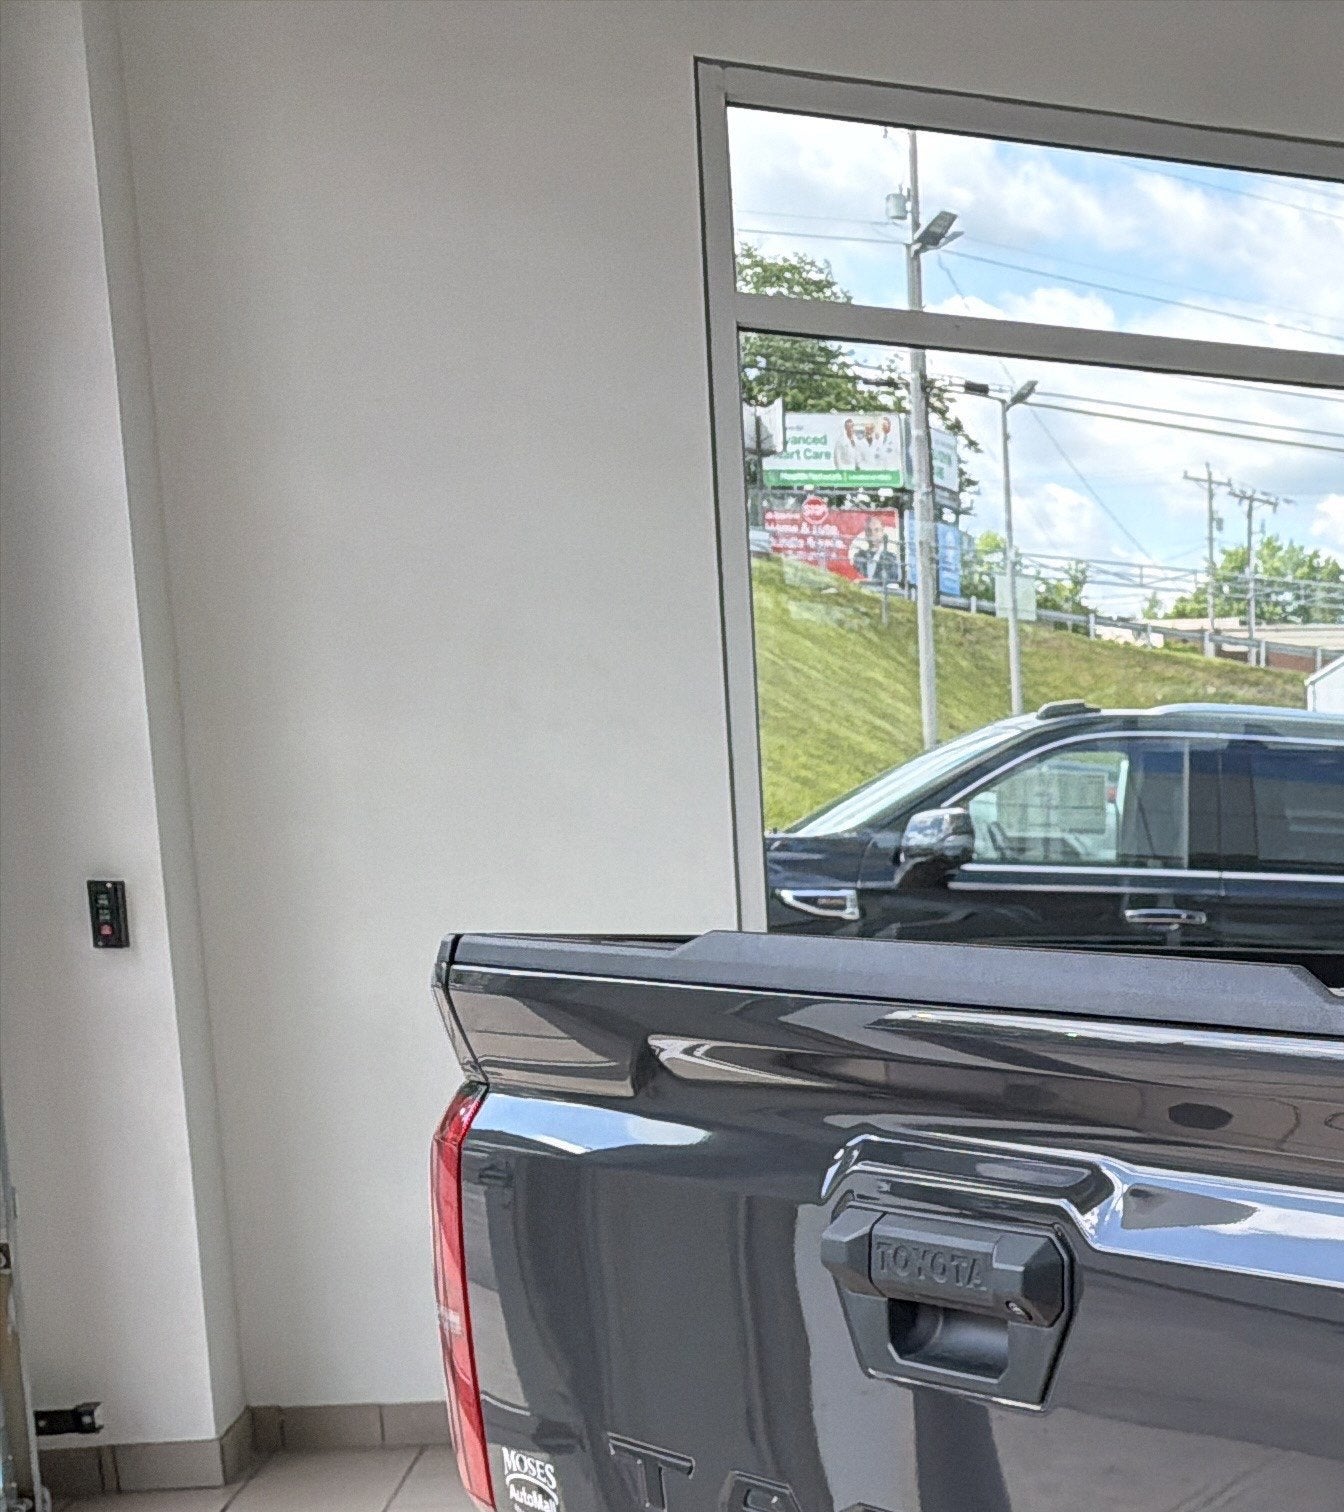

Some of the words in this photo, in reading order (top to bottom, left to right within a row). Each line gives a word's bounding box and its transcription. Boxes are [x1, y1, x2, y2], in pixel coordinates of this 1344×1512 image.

[803, 447, 832, 460] Care
[875, 1242, 988, 1292] TOYOTA
[501, 1446, 557, 1490] MOSES
